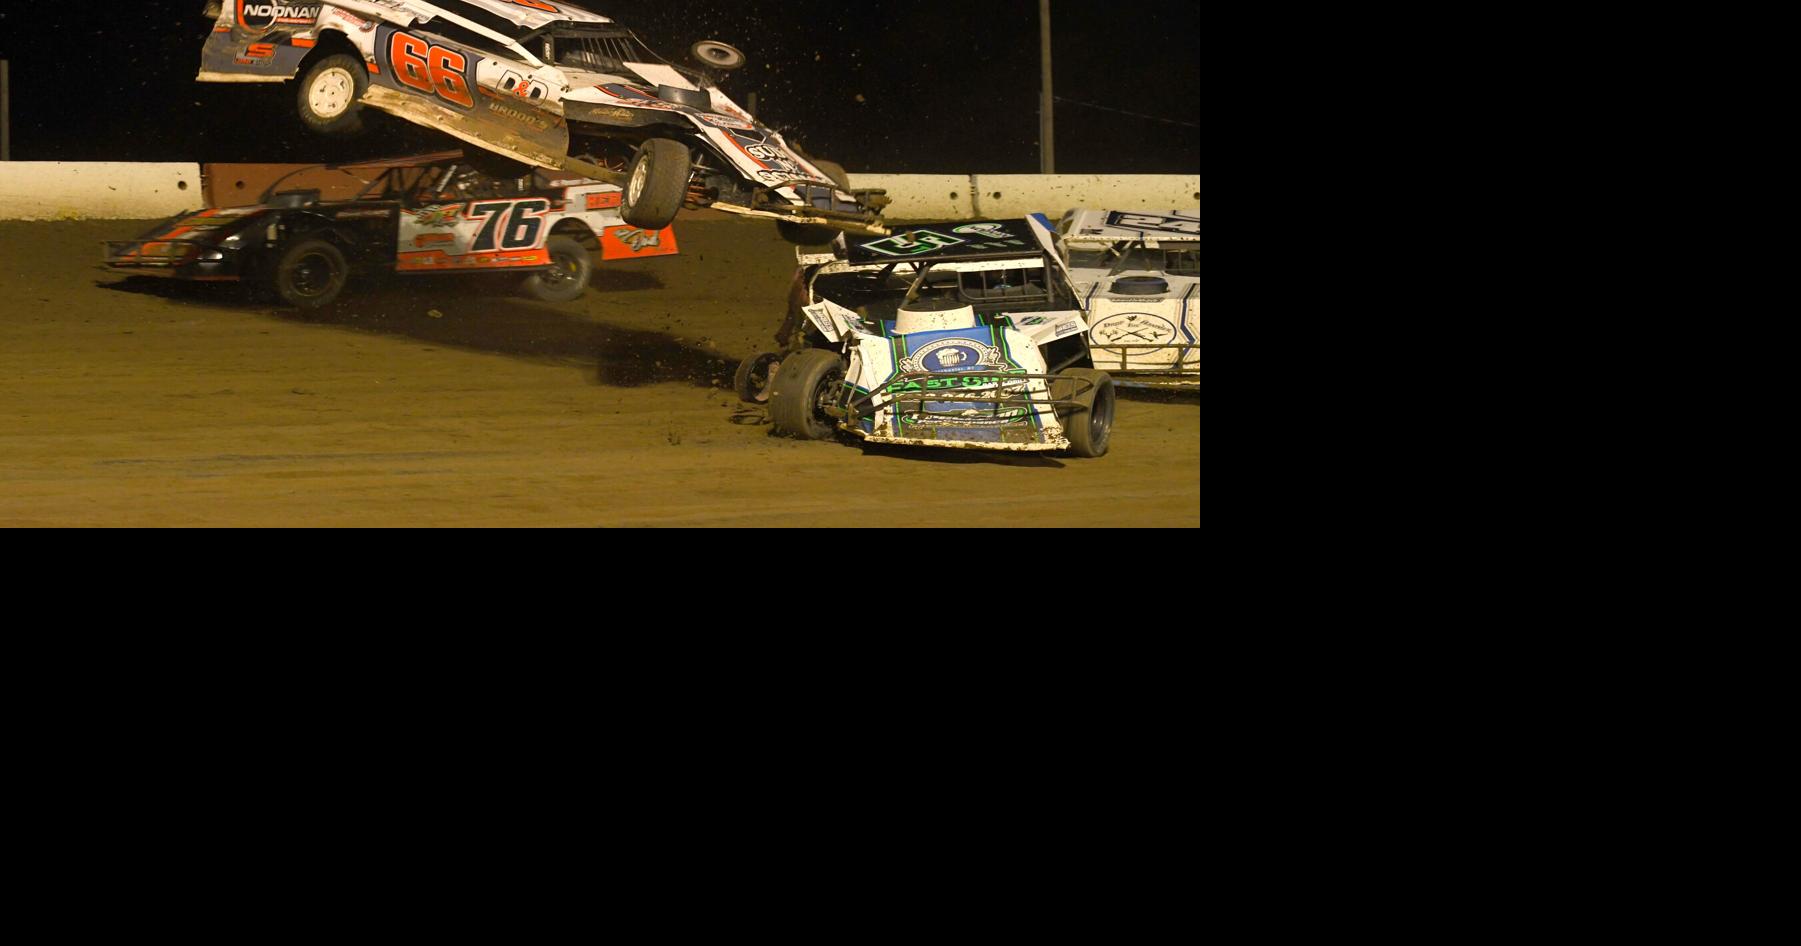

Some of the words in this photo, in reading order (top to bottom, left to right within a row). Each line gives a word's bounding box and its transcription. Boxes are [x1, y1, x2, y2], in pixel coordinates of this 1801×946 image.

[243, 4, 320, 18] NOONAN
[390, 31, 475, 109] 66
[467, 197, 550, 252] 76
